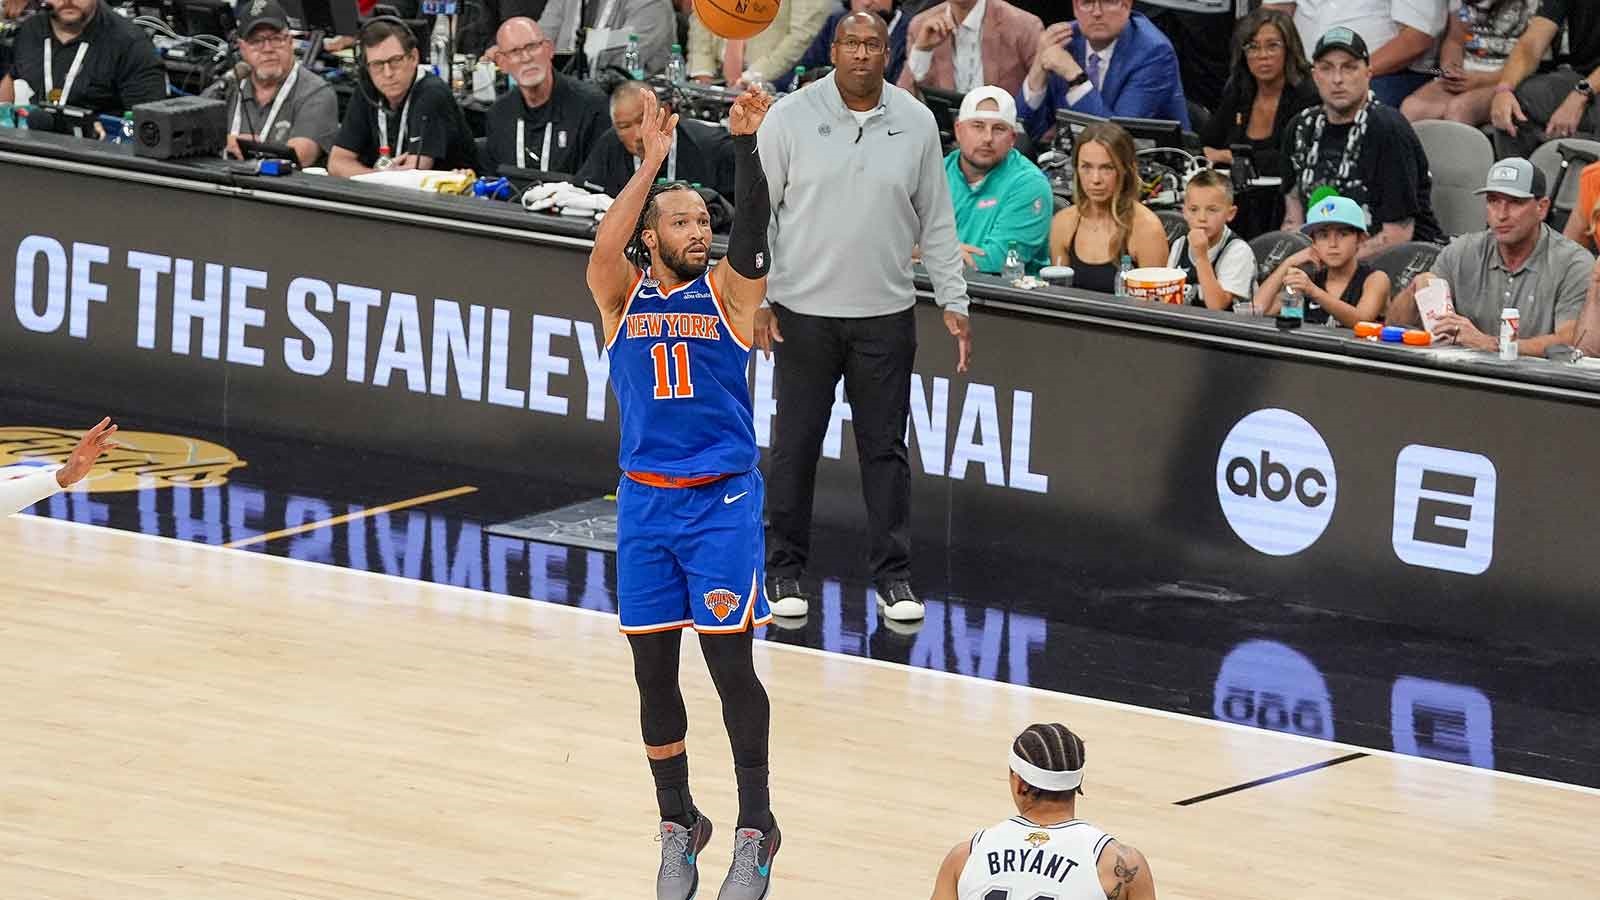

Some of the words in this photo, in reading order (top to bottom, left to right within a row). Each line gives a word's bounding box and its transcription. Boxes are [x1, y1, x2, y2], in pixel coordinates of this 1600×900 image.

[14, 234, 110, 339] OF
[127, 250, 267, 367] THE
[283, 276, 610, 421] STANLEY
[626, 313, 663, 338] NEW
[664, 312, 720, 341] YORK
[651, 342, 694, 400] 11
[1226, 449, 1327, 508] abc
[987, 848, 1080, 883] BRYANT
